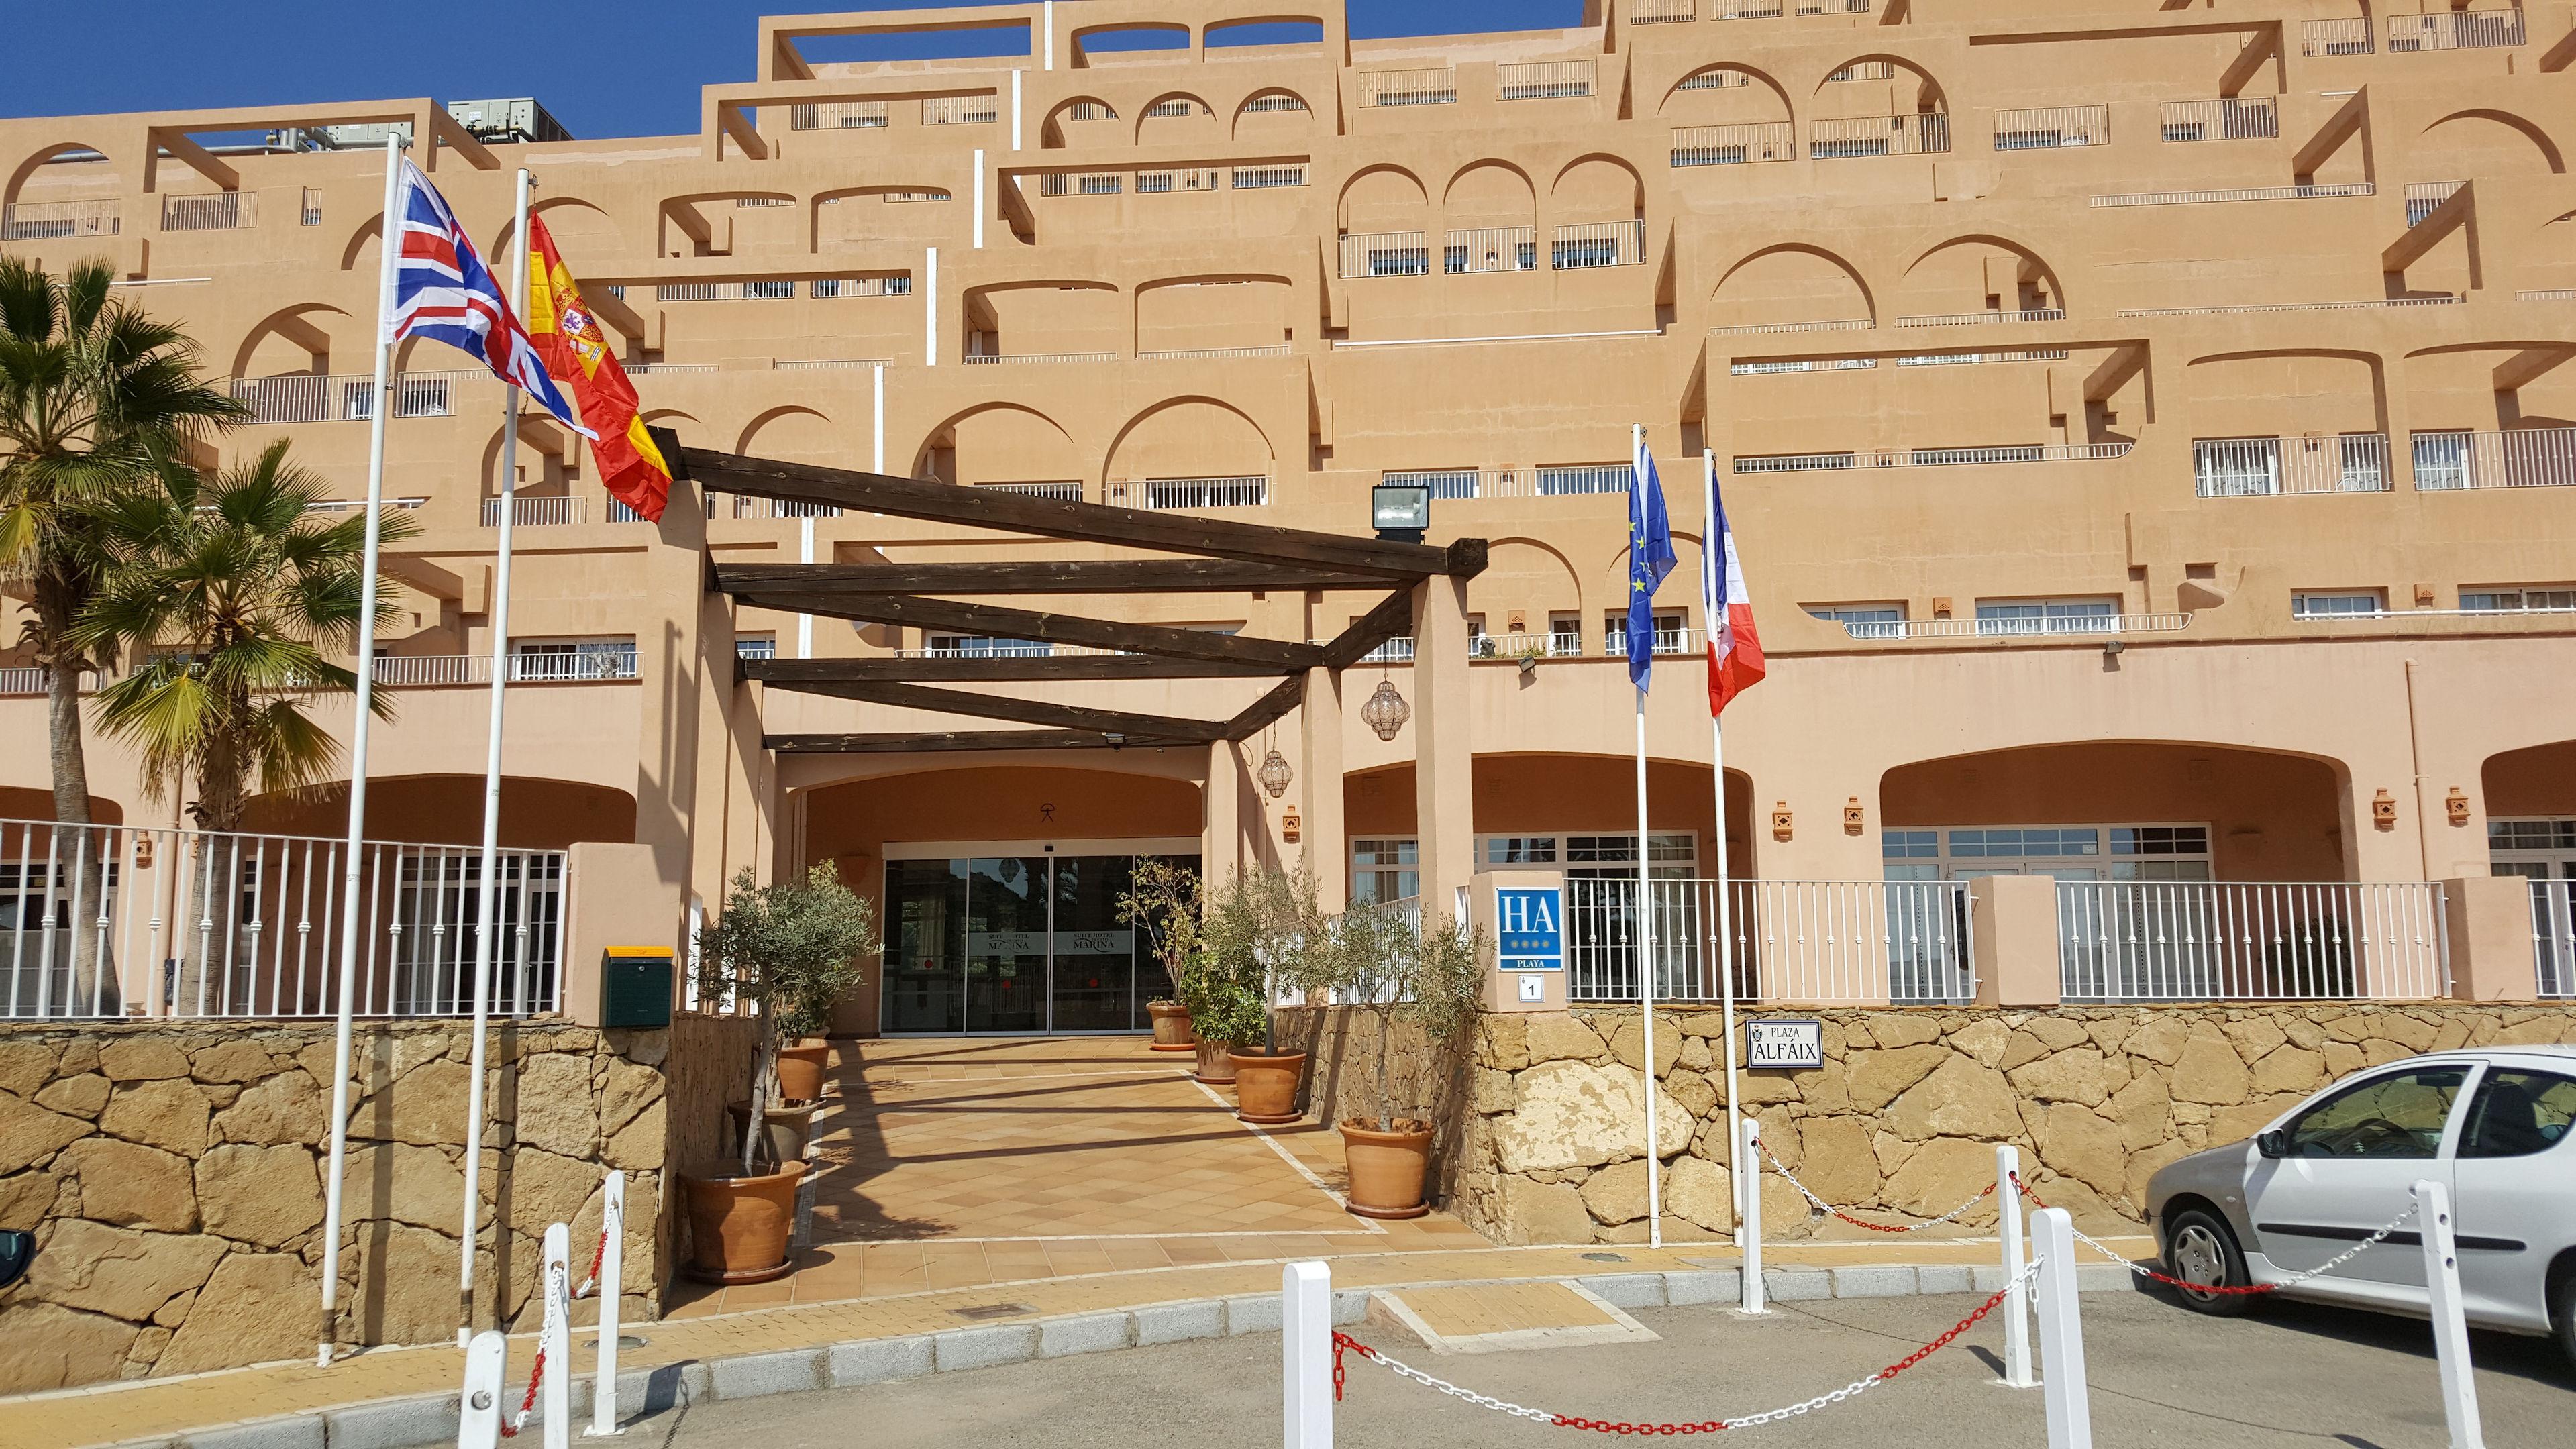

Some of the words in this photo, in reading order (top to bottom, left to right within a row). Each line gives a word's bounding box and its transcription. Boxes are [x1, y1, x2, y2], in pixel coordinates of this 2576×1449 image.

[1501, 896, 1557, 933] HA
[1074, 940, 1114, 949] MARINA
[1517, 959, 1545, 968] PLAYA
[1529, 984, 1535, 996] 1
[1771, 1027, 1800, 1038] PLAZA
[1754, 1038, 1817, 1059] ALFÁIX
